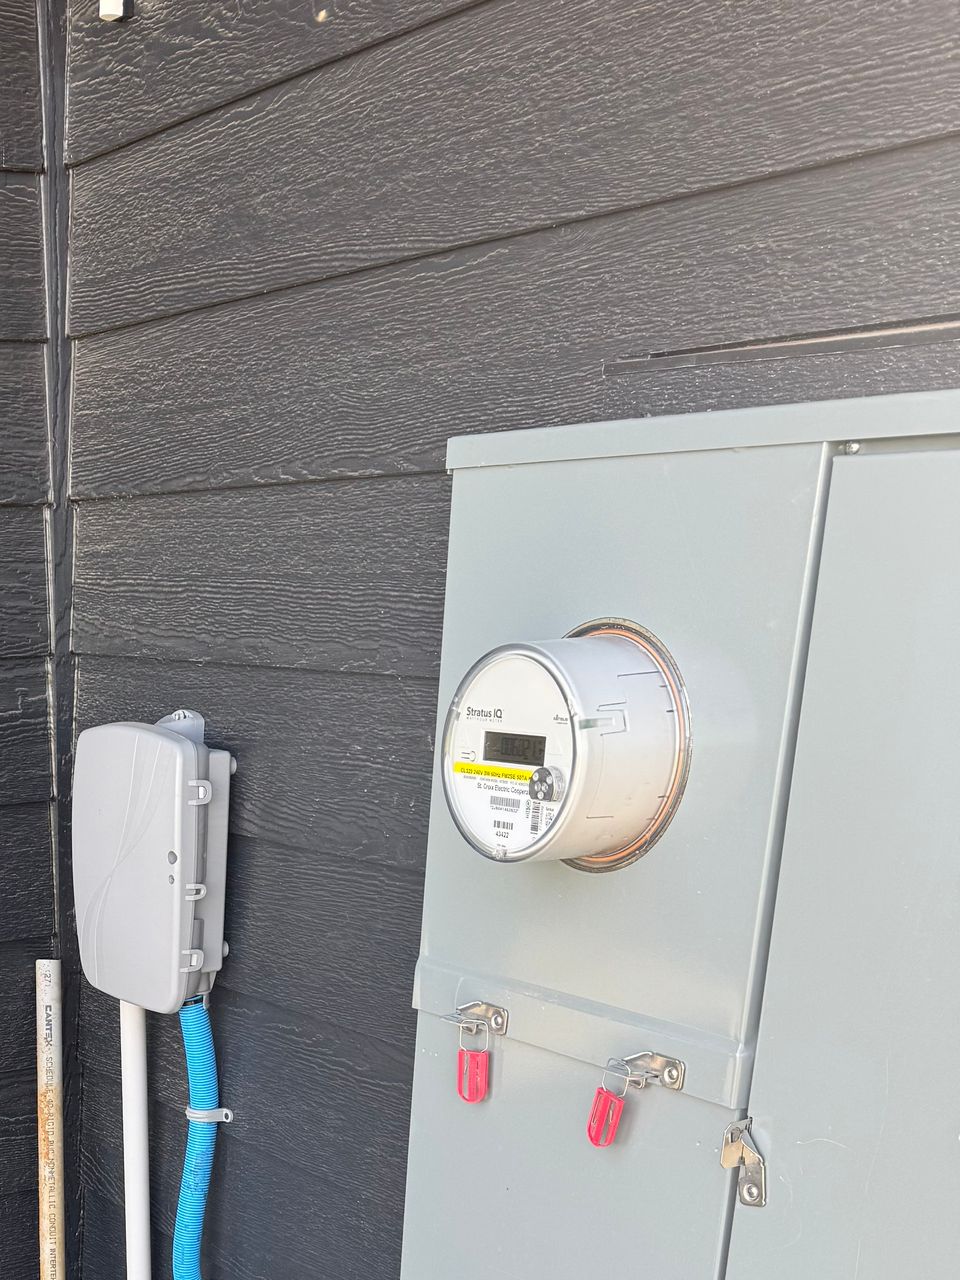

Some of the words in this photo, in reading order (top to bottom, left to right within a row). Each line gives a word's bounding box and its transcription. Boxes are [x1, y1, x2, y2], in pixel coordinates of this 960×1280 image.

[466, 706, 492, 718] Stratus
[493, 708, 503, 719] IQ
[494, 784, 510, 793] Electric
[45, 1004, 53, 1047] CANTEX
[45, 1056, 55, 1093] SCHEDULE
[47, 1112, 55, 1136] RIGID
[47, 1158, 56, 1209] NONMETALLIC
[48, 1213, 57, 1245] CONDUIT
